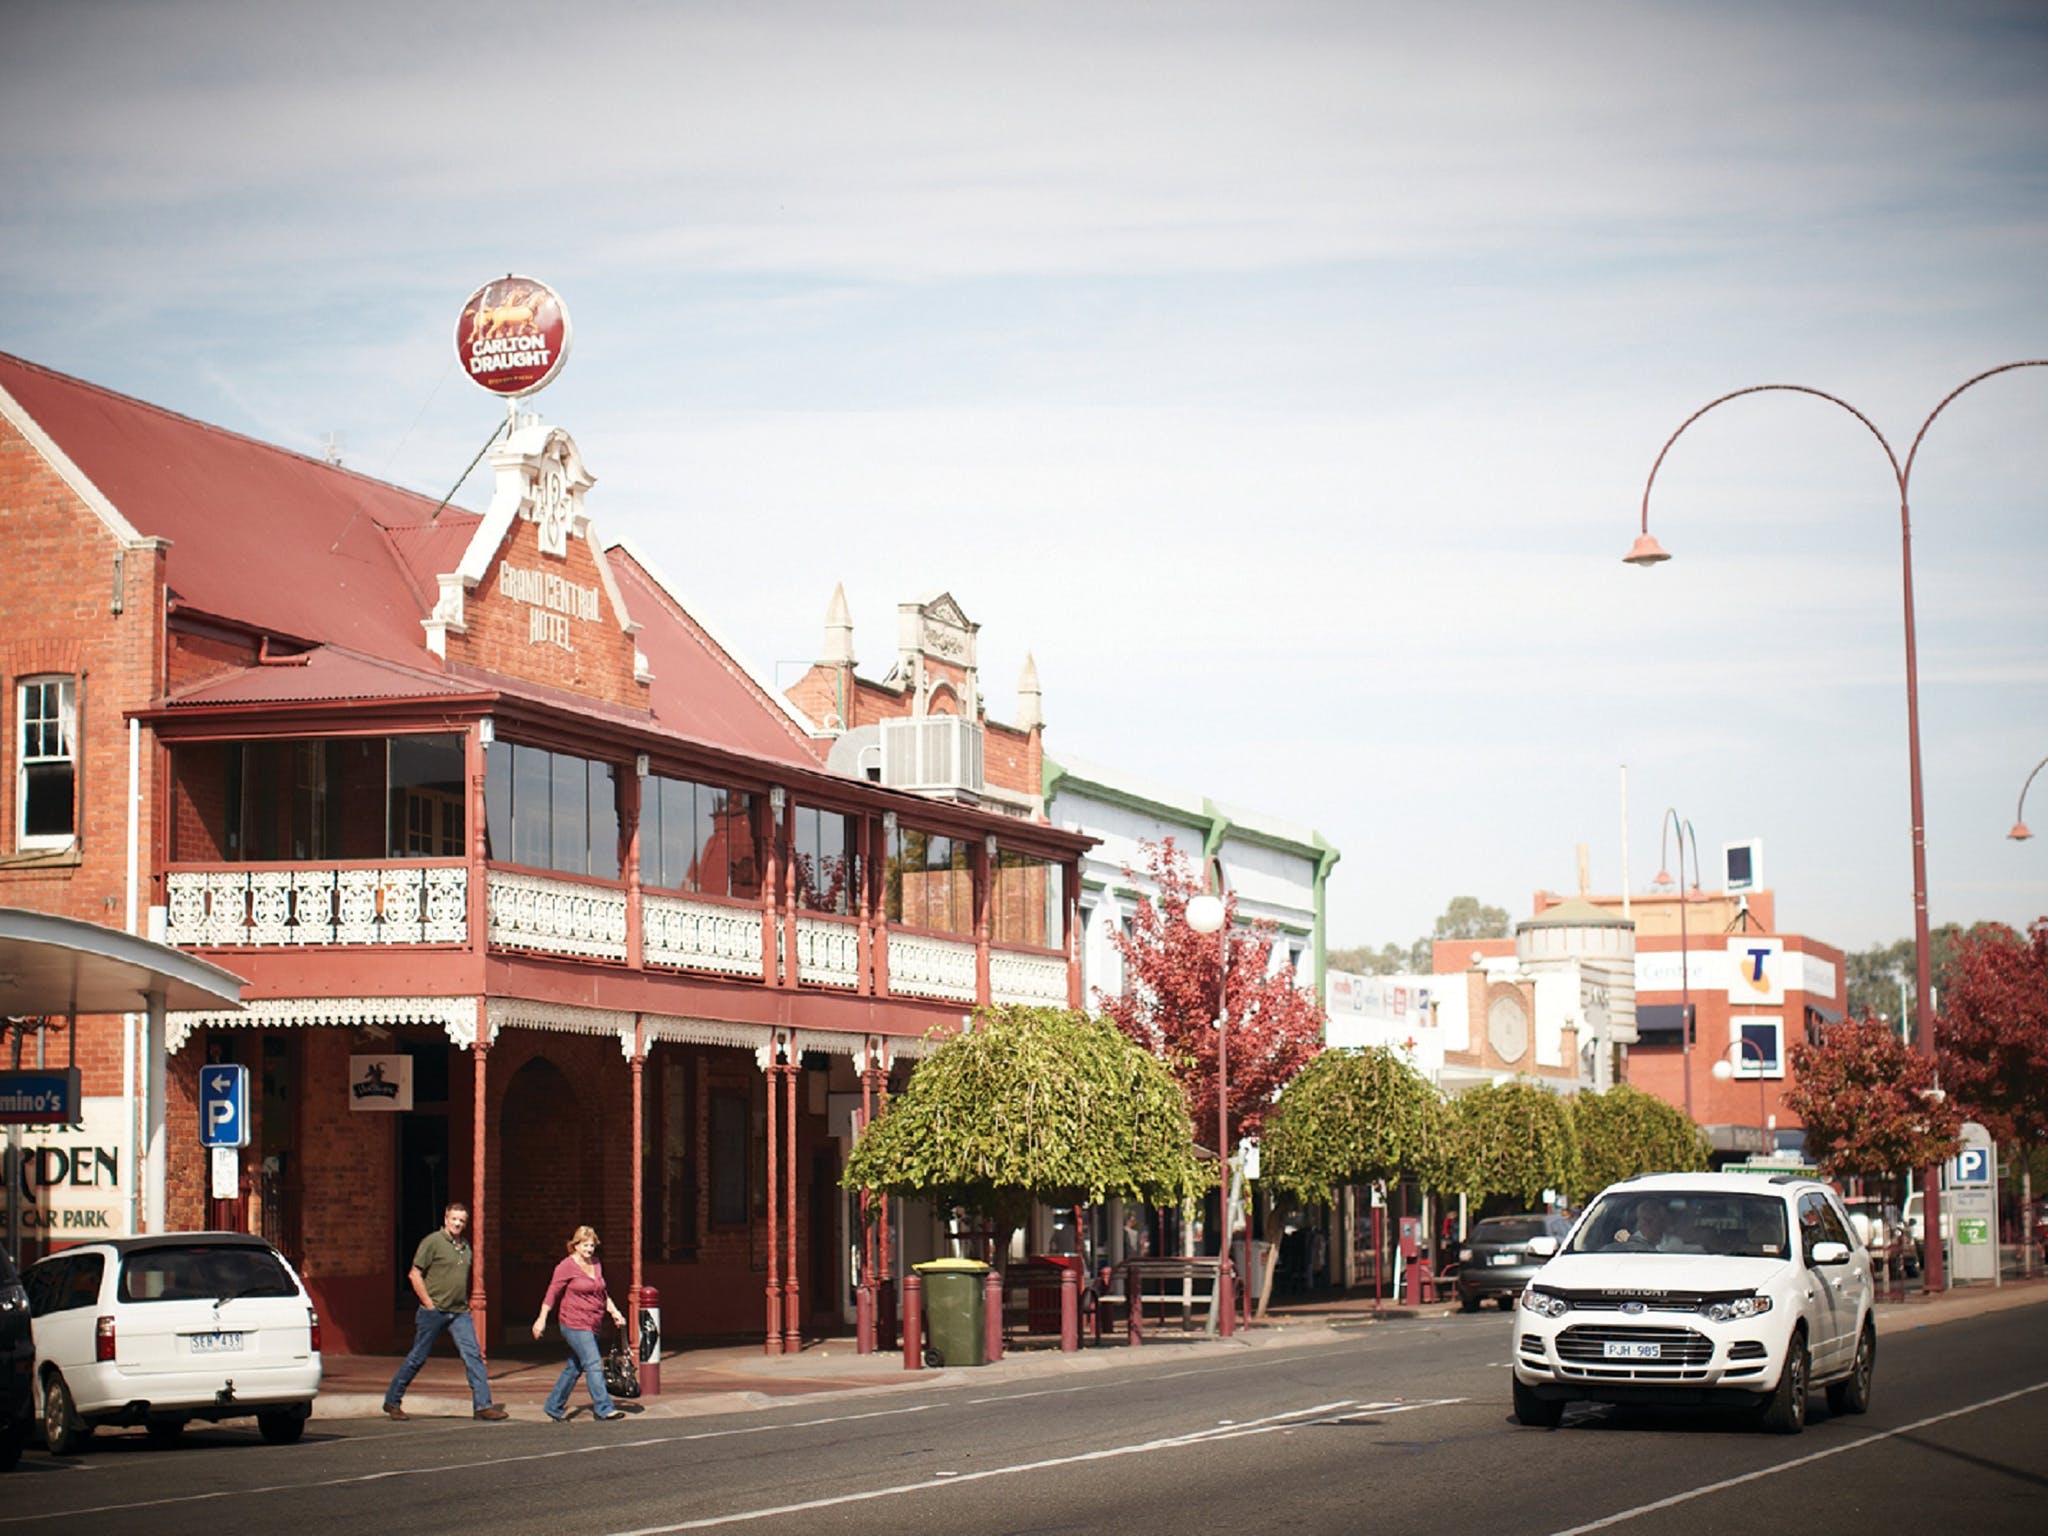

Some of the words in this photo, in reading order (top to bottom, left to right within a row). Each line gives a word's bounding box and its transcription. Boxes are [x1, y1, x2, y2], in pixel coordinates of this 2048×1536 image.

[472, 334, 545, 356] CARLTON
[469, 350, 551, 374] DRAUGHT
[500, 560, 543, 606] GRAND
[545, 572, 602, 623] CENTRAL
[529, 607, 573, 652] HOTEL
[1748, 949, 1771, 982] T
[0, 1090, 61, 1111] mino's
[209, 1100, 235, 1137] P
[0, 1147, 118, 1203] RDEN
[1961, 1151, 1982, 1179] P
[22, 1209, 58, 1229] CAR
[63, 1210, 110, 1228] PARK
[1608, 1345, 1631, 1356] PJH
